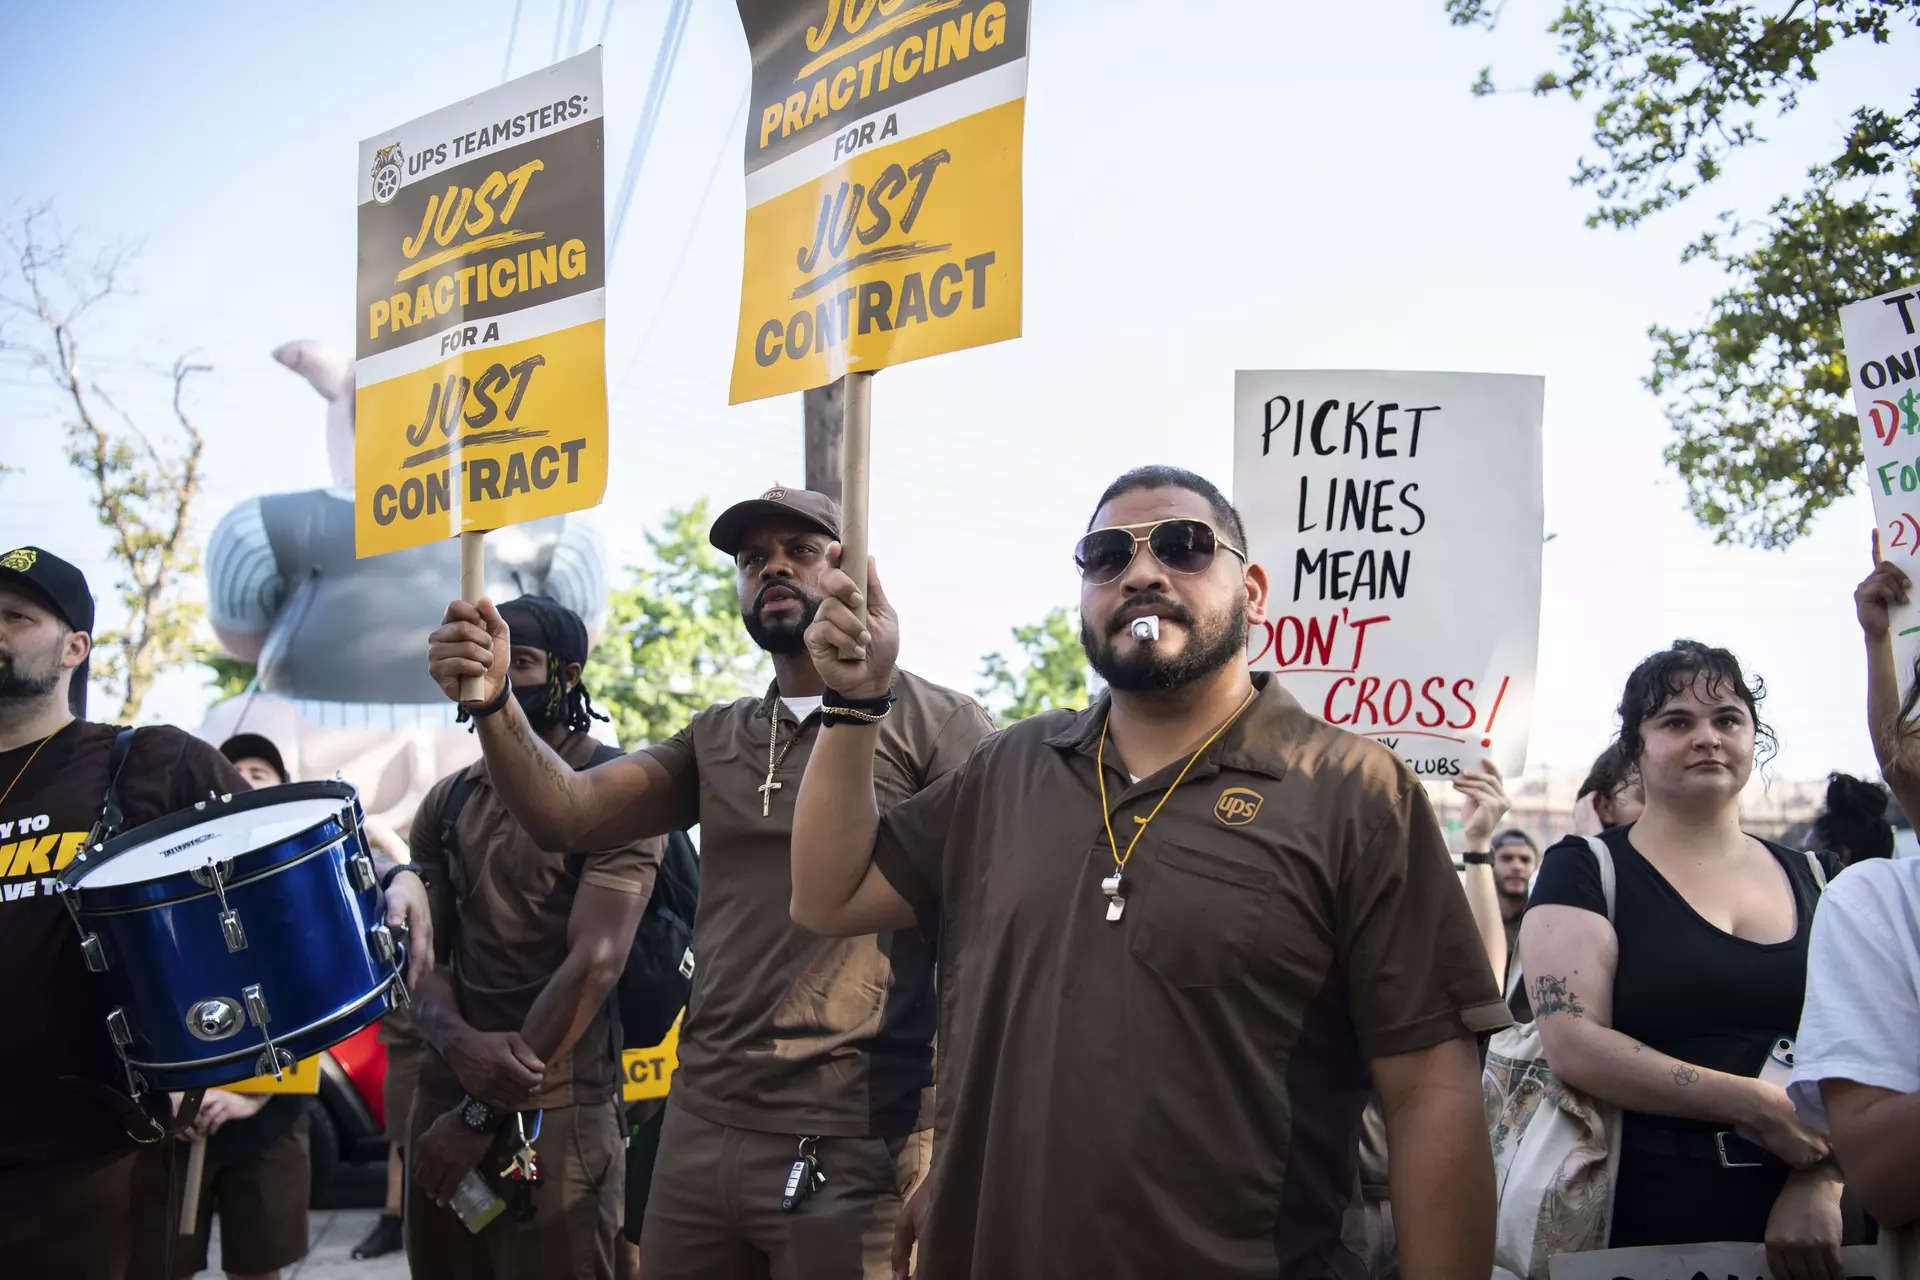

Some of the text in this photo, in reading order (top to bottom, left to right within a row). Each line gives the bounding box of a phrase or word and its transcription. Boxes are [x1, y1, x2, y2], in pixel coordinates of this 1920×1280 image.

[759, 2, 1007, 149] PRACTICING
[408, 95, 588, 176] UPS TEAMSTERS:
[833, 113, 898, 161] FOR A
[402, 159, 545, 259] JUST
[796, 148, 951, 273] JUST
[370, 238, 587, 339] PRACTICING
[755, 251, 996, 368] CONTRACT
[1882, 290, 1920, 334] T
[440, 322, 500, 356] FOR A
[1860, 345, 1920, 389] ON
[406, 354, 546, 447] JUST
[1261, 395, 1441, 460] PICKET
[1297, 475, 1426, 536] LINES
[1876, 456, 1920, 496] FO
[1292, 548, 1411, 602] MEAN
[1323, 675, 1510, 748] CROSS!
[1405, 757, 1461, 776] LUBS
[18, 814, 50, 835] TO
[1219, 796, 1256, 818] ups
